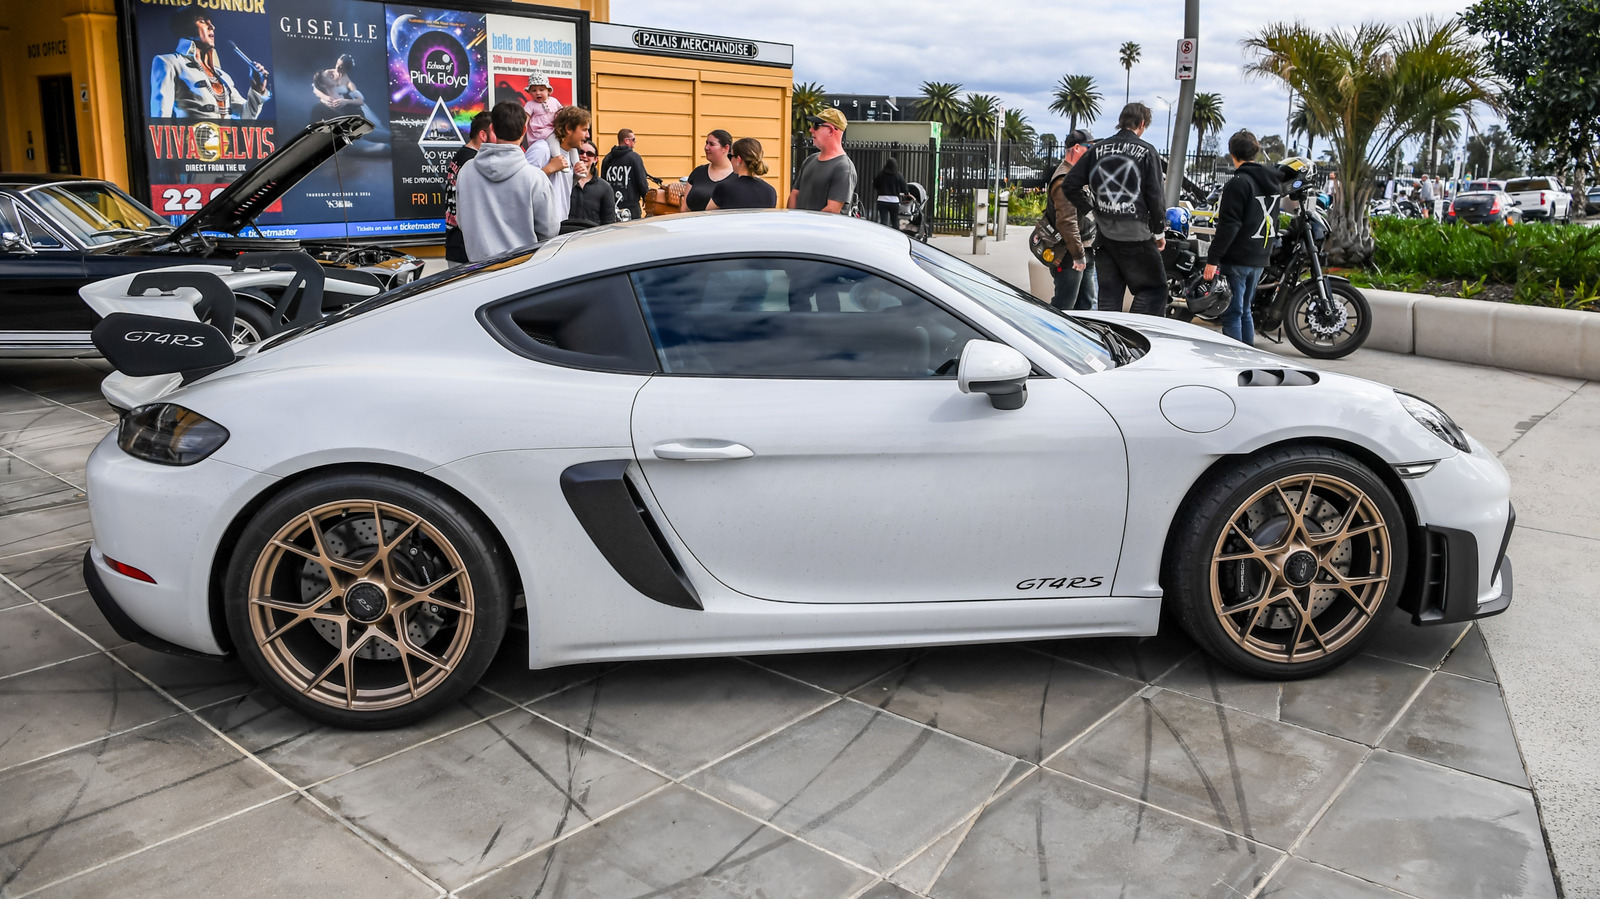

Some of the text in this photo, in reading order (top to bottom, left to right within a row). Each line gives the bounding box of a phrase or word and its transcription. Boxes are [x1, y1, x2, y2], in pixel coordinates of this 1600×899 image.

[280, 16, 378, 39] GISELLE
[27, 40, 67, 58] BOX OFFICE
[492, 33, 572, 56] belle and sebastian
[643, 33, 749, 55] PALAIS MERCHANDISE
[426, 61, 454, 72] Echoes of
[492, 54, 503, 64] 30th
[504, 56, 529, 67] anniversary
[410, 70, 469, 88] Pink Floyd
[149, 125, 275, 159] VIVA ELVIS
[424, 151, 436, 159] 60
[185, 163, 247, 172] DIRECT FROM THE UK
[421, 165, 439, 173] PINK
[162, 188, 203, 211] 22
[411, 192, 442, 205] FRI 11
[400, 222, 442, 231] ticketmaster
[124, 331, 206, 347] GT4RS
[1016, 576, 1104, 590] GT4RS
